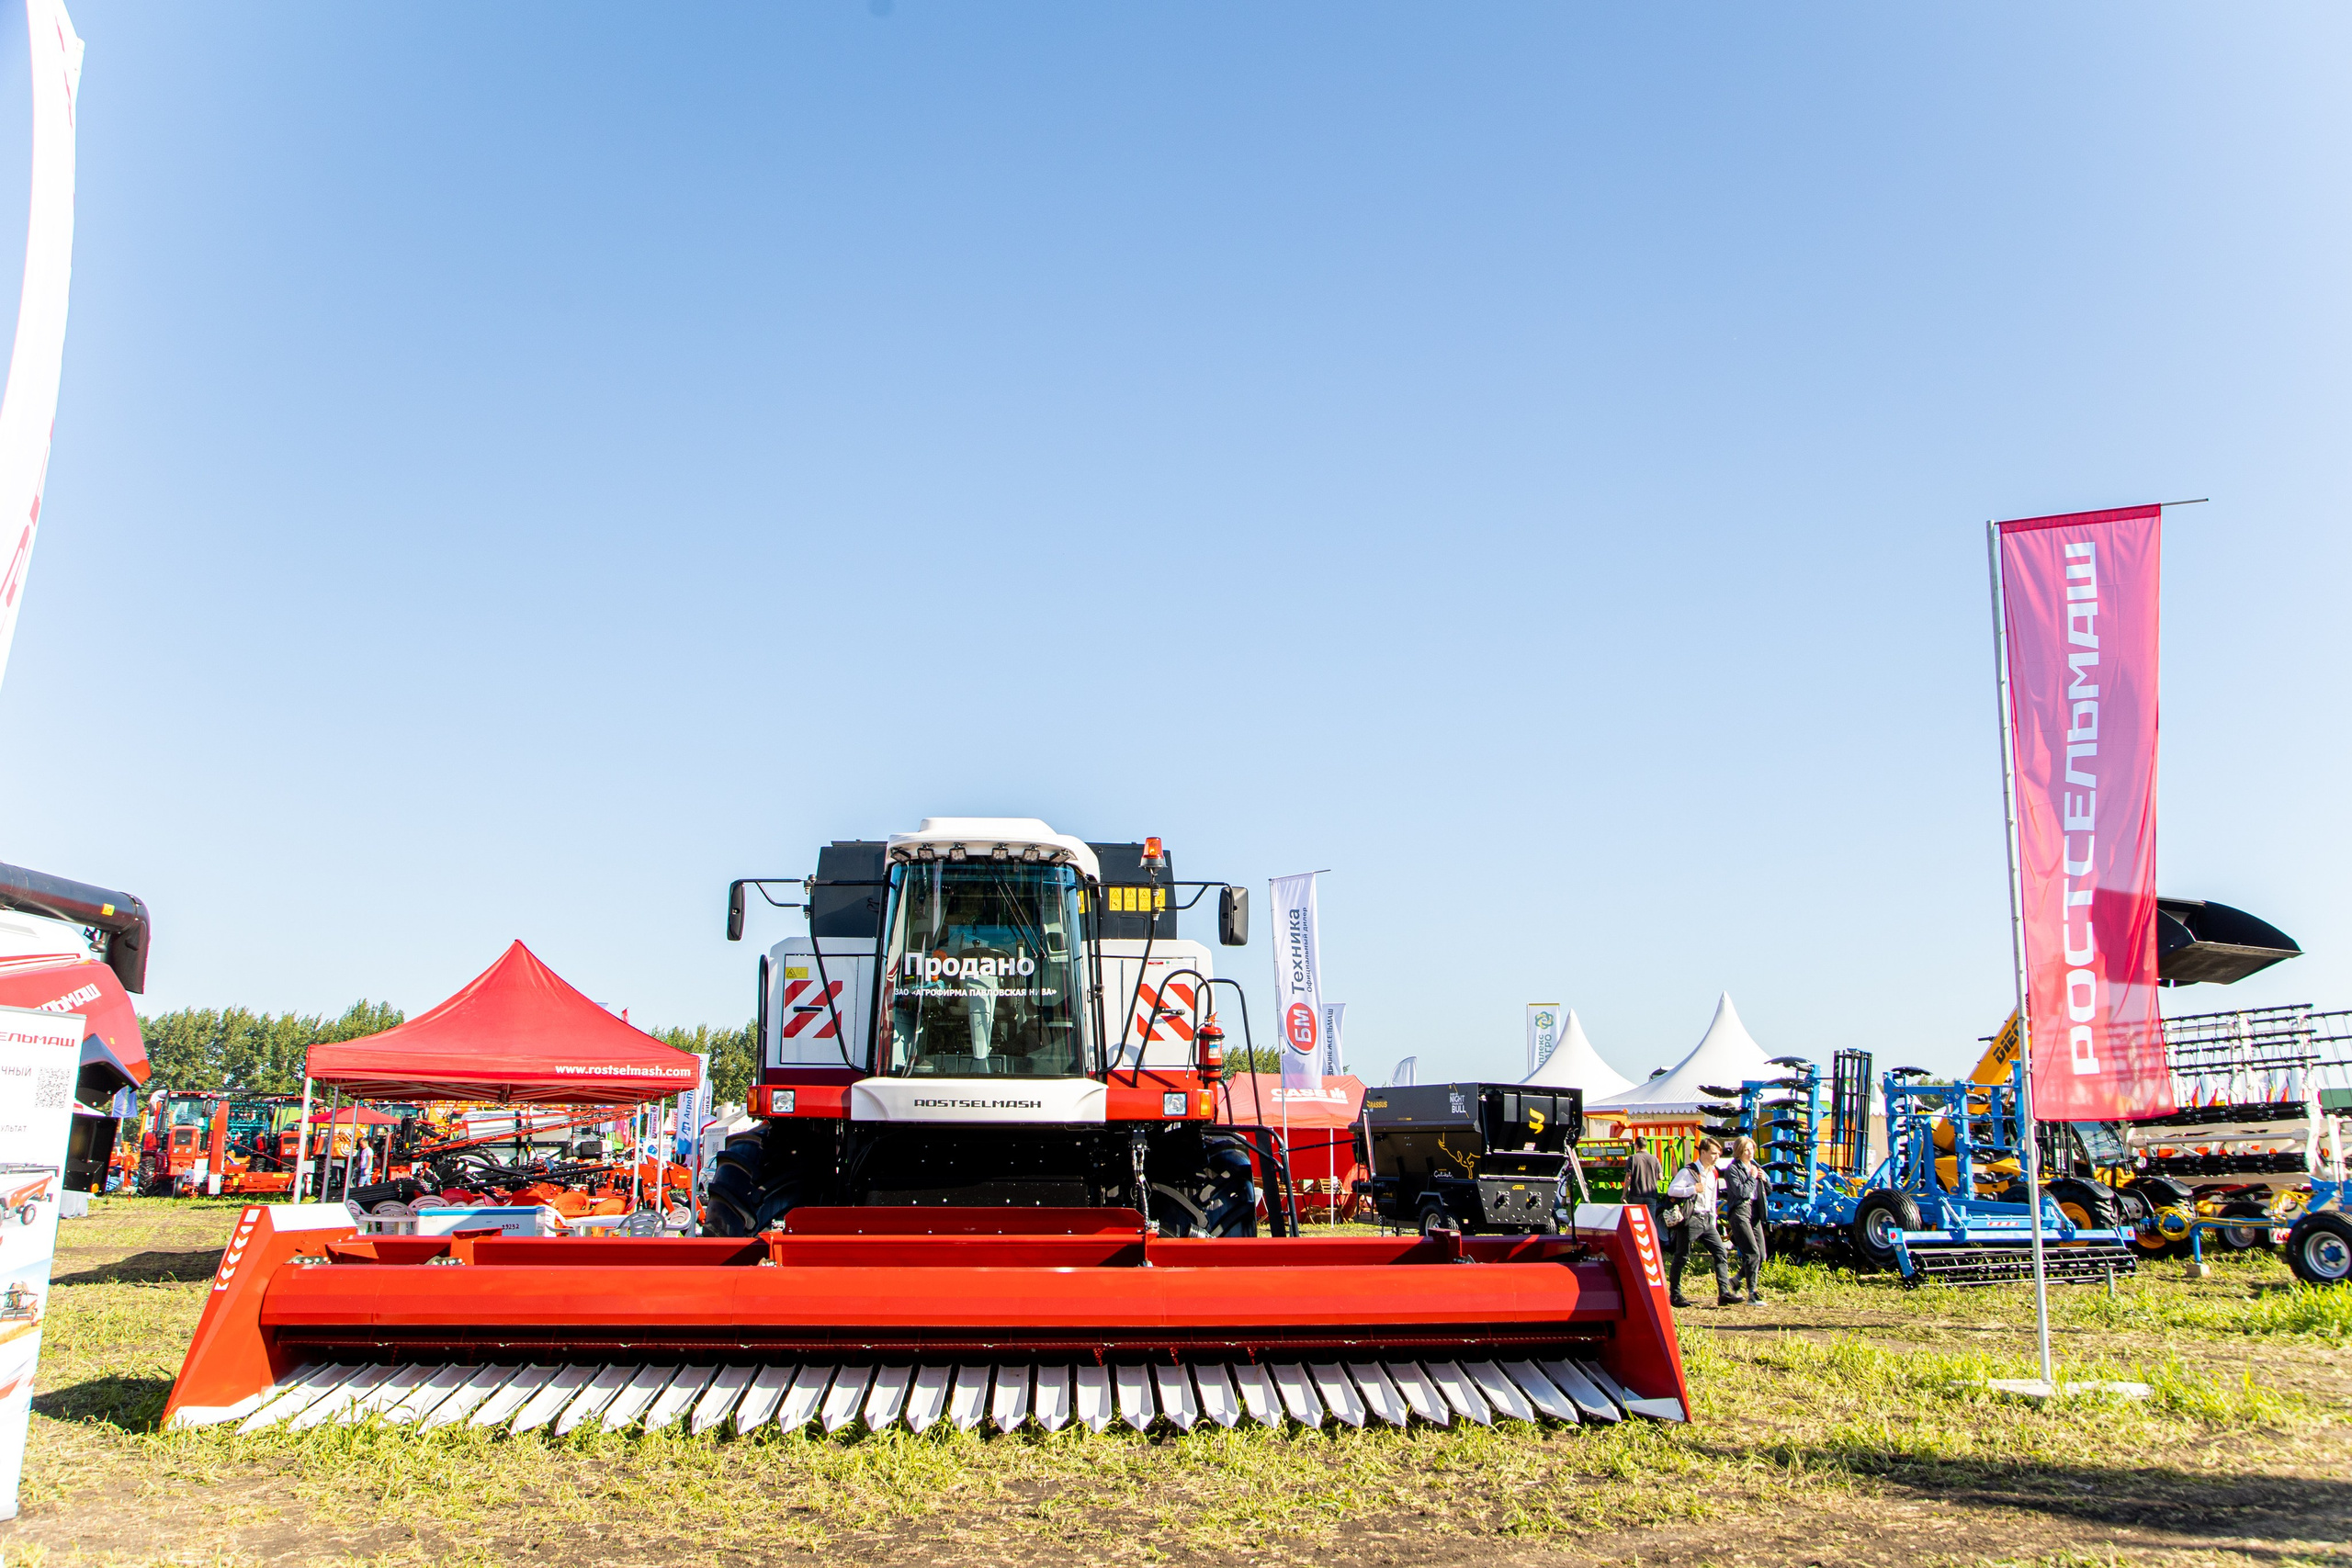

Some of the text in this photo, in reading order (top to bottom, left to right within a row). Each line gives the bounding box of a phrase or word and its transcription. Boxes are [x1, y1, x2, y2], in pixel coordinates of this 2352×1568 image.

[2064, 541, 2100, 1076] РОСТСЕЛЬМАШ
[904, 952, 1035, 982] Продано
[1303, 934, 1313, 993] Официальный
[1289, 908, 1312, 1043] БМ Техника
[33, 982, 102, 1013] ЛЬМАШ
[911, 988, 967, 998] «АГРОФИРМА
[969, 988, 1026, 997] ПАВЛОВСКАЯ
[555, 1065, 691, 1077] www.rostselmash.com
[913, 1099, 1042, 1108] ROSTSELMASH
[1271, 1088, 1328, 1098] CASE
[1452, 1105, 1466, 1113] BULL
